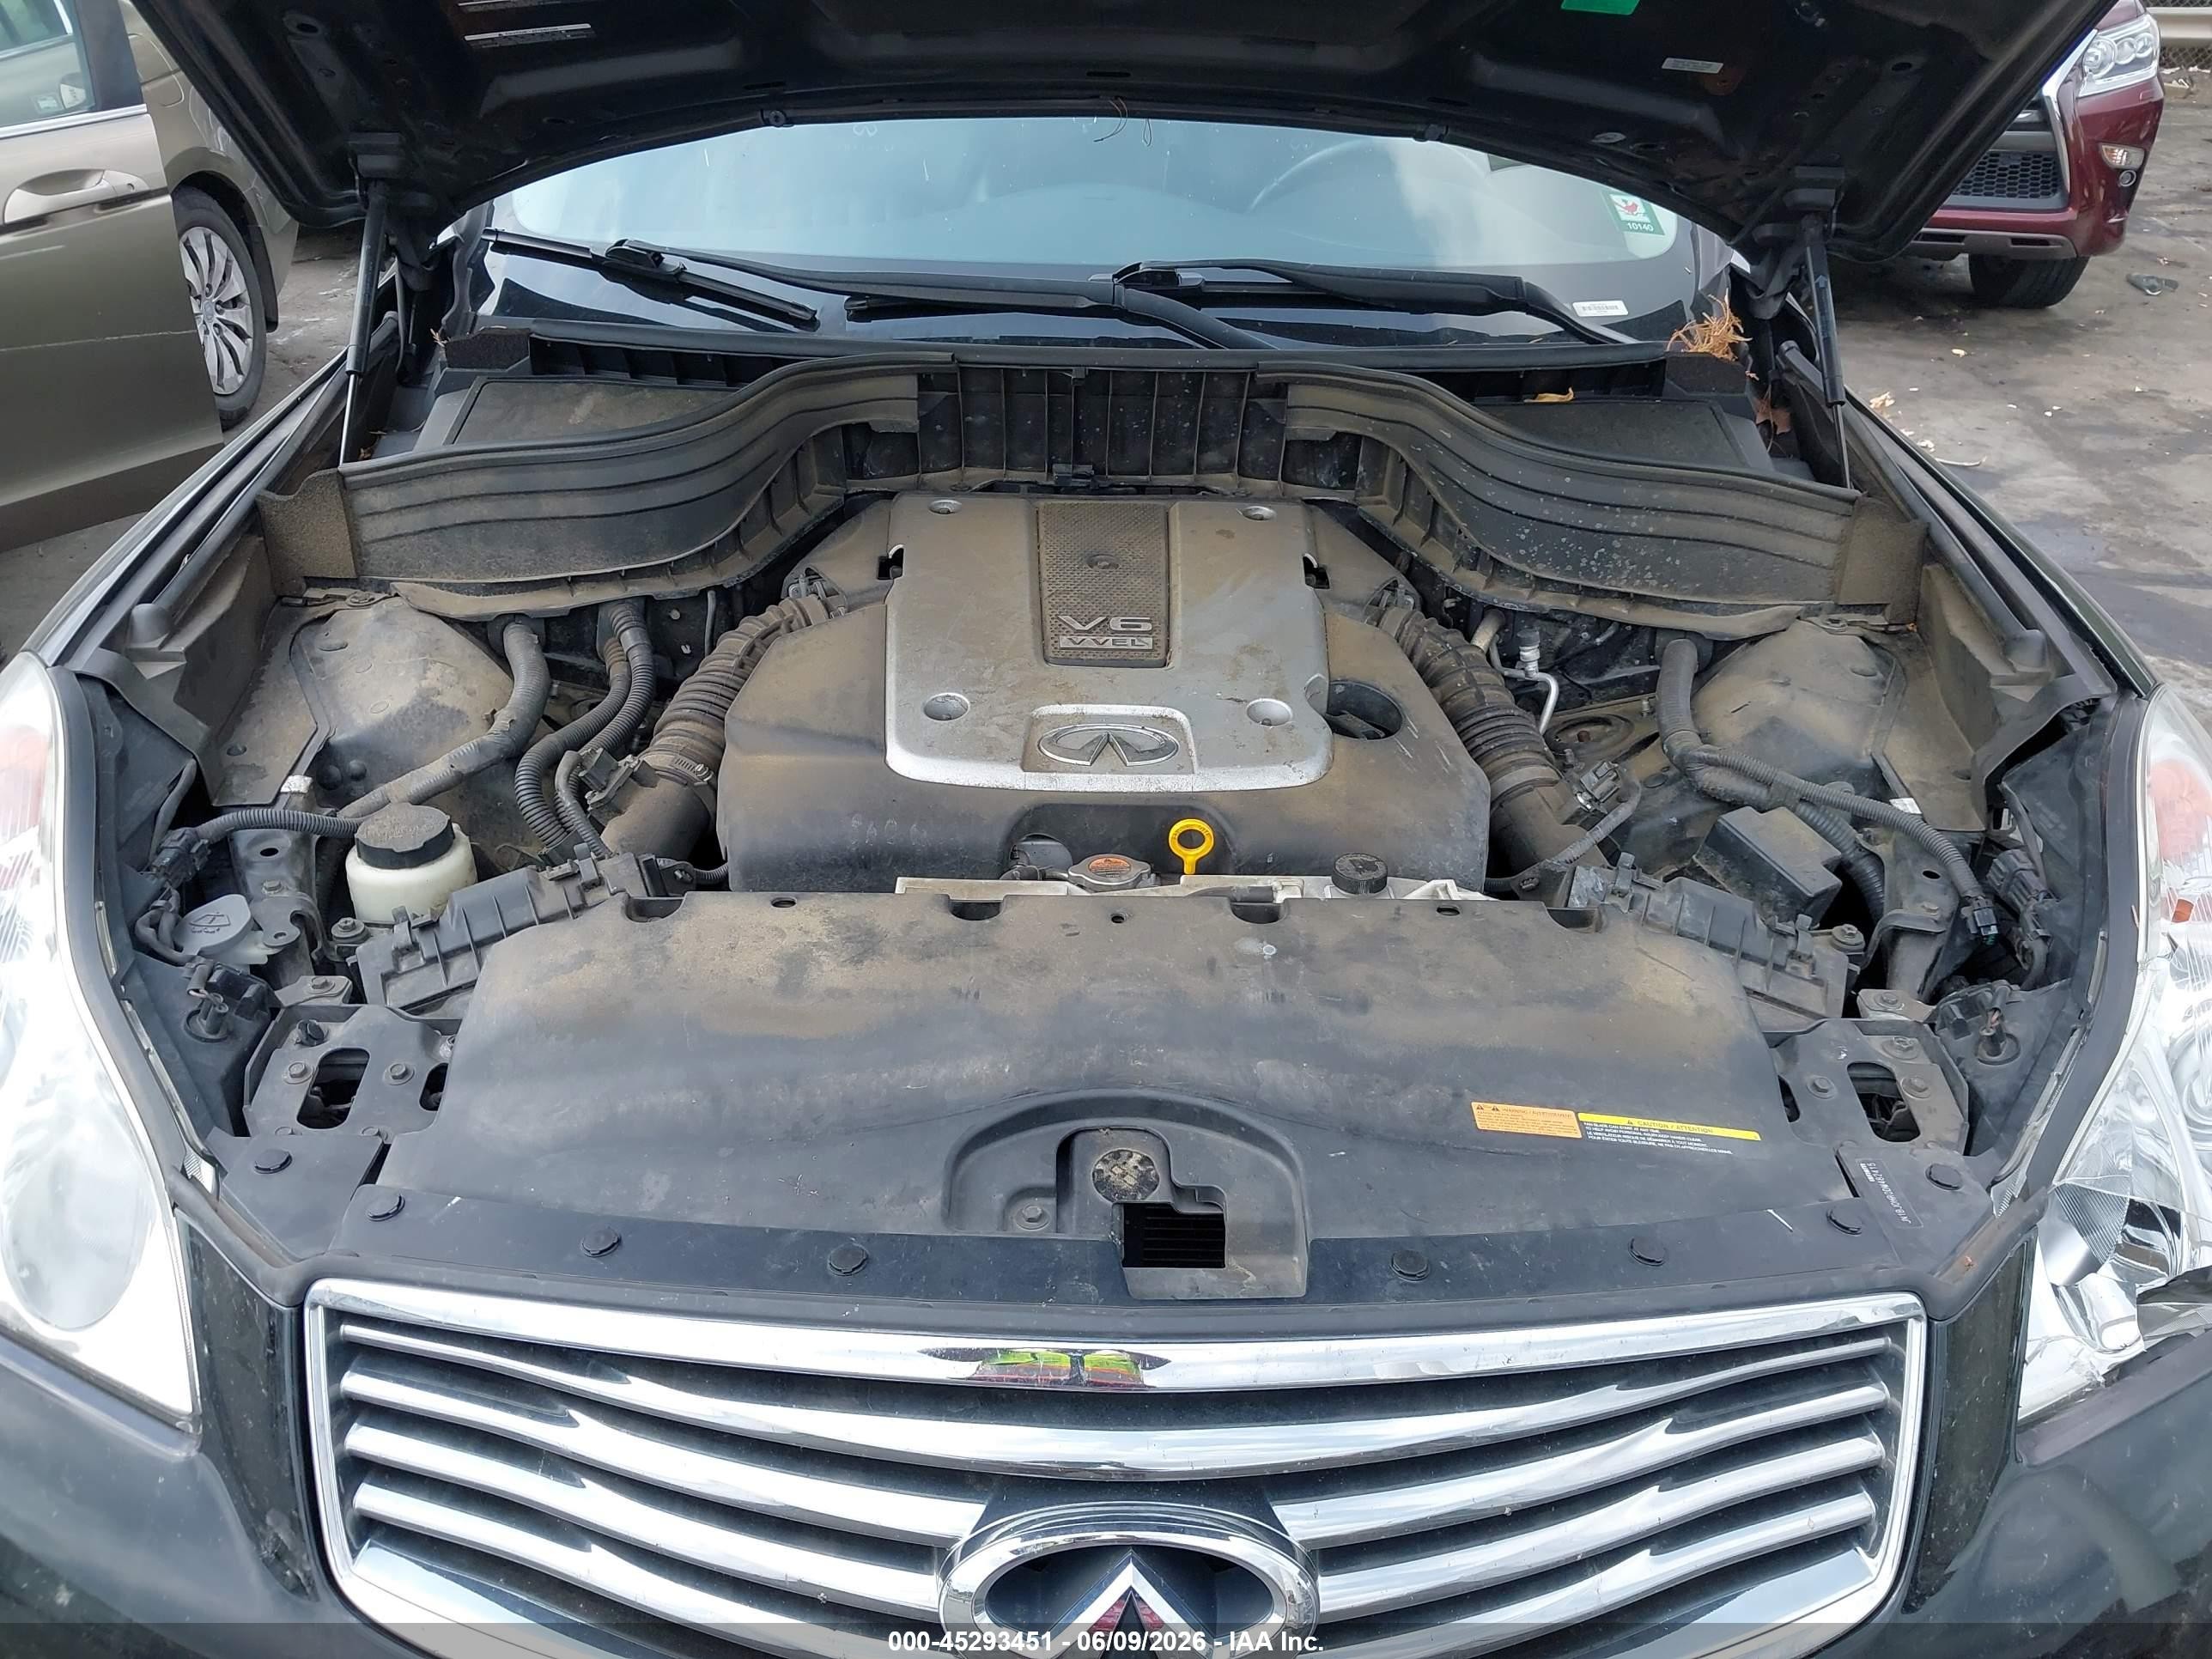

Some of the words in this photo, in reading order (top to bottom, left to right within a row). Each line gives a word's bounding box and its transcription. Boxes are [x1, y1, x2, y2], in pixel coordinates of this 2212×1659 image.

[1627, 222, 1654, 232] 10140
[1057, 615, 1152, 632] V6
[1066, 636, 1148, 647] VVEL
[1638, 1120, 1668, 1128] CAUTION
[1676, 1125, 1714, 1133] ATTENTION
